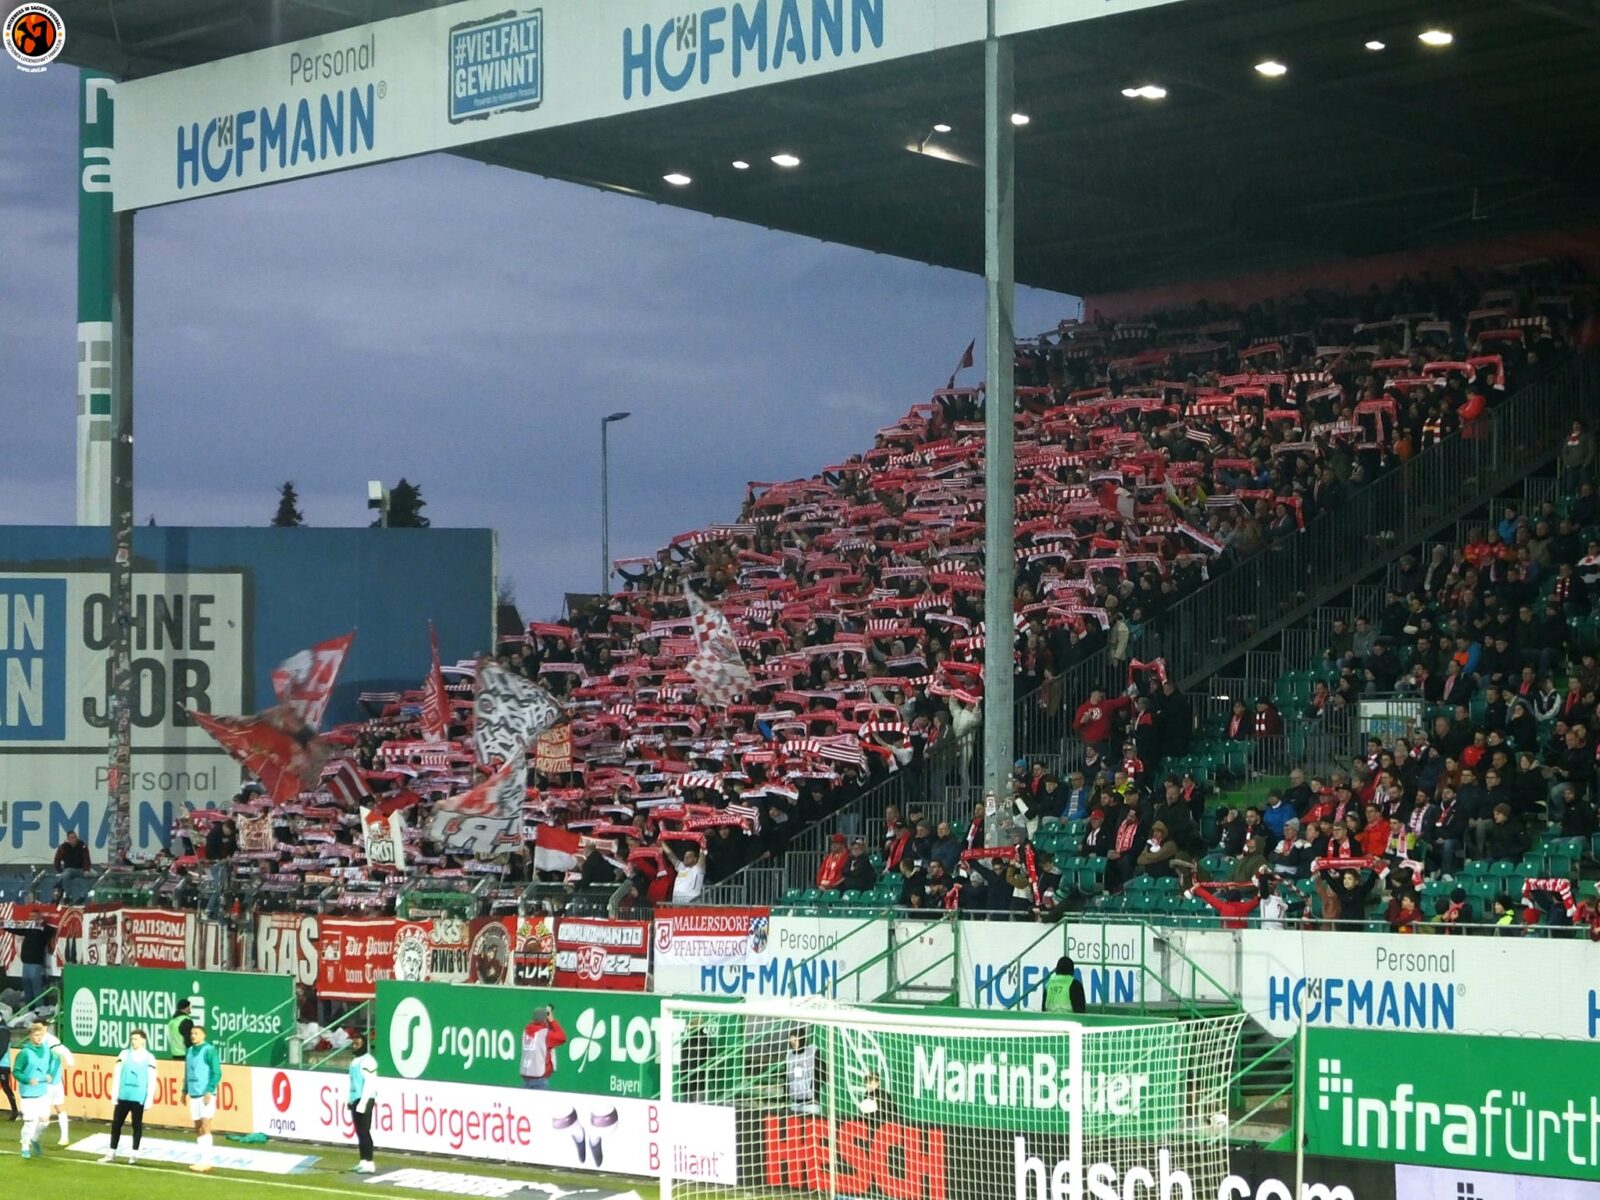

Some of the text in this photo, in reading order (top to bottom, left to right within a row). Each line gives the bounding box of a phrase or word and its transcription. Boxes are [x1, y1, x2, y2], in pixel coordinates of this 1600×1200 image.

[290, 34, 376, 87] Personal
[455, 20, 537, 67] #VIELFALT
[455, 52, 537, 98] GEWINNT
[83, 593, 215, 650] OHNE
[83, 657, 211, 728] JOB
[95, 766, 216, 791] Prsonal
[673, 915, 749, 932] MALLERSDORF
[780, 929, 838, 951] Personal
[673, 938, 748, 958] PFAFFENBERG
[1067, 936, 1135, 961] Personal
[1376, 947, 1456, 973] Personal
[99, 988, 176, 1019] FRANKEN
[974, 963, 1135, 1008] HOFNN
[211, 1006, 281, 1036] Sparkasse
[212, 1040, 247, 1065] ürth
[438, 1026, 515, 1070] signia
[913, 1045, 1149, 1117] MartinBauer
[320, 1085, 532, 1149] Sigia Hörgeräte
